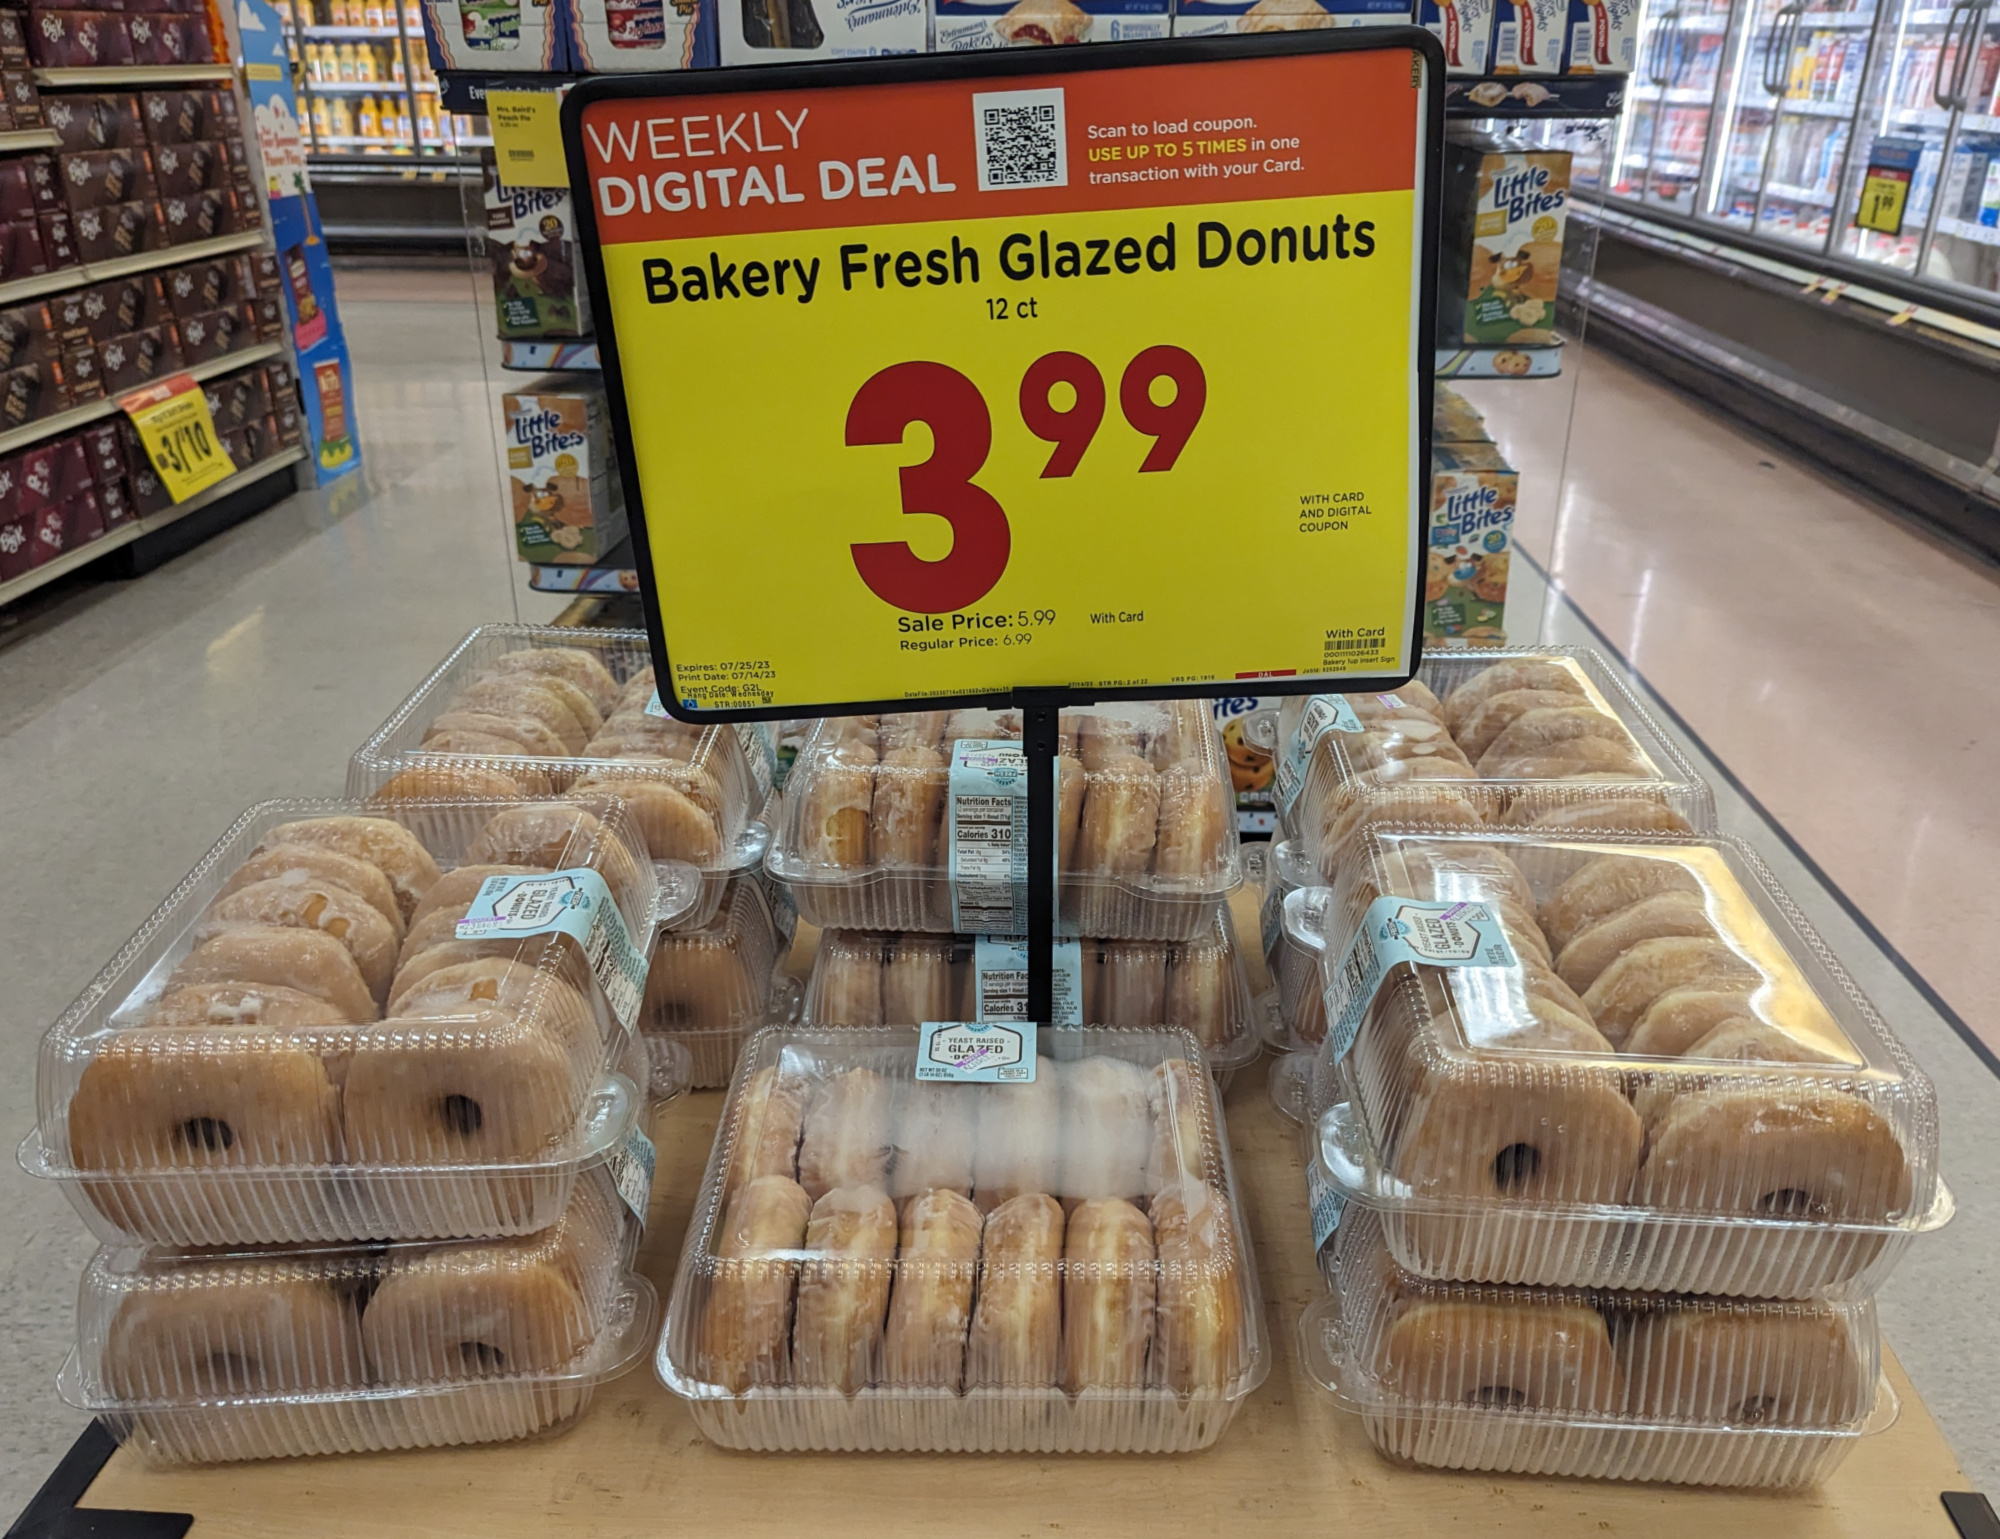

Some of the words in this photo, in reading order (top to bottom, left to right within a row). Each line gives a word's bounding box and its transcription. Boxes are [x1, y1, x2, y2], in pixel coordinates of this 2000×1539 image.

[1111, 19, 1120, 40] 6
[1411, 50, 1420, 88] AKERY
[586, 108, 809, 164] WEEKLY
[1087, 123, 1127, 139] Scan
[1131, 123, 1148, 136] to
[1153, 119, 1188, 134] load
[1193, 117, 1257, 135] coupon.
[1089, 147, 1122, 162] USE
[1126, 145, 1150, 159] UP
[1154, 143, 1178, 157] TO
[1182, 141, 1193, 157] 5
[1196, 138, 1247, 155] TIMES
[1251, 137, 1265, 151] in
[1270, 136, 1300, 149] one
[1089, 166, 1179, 184] transaction
[1184, 163, 1218, 178] with
[1223, 162, 1258, 178] your
[1263, 157, 1305, 173] Card.
[598, 165, 805, 216] DIGITAL
[819, 153, 957, 201] DEAL
[1494, 167, 1549, 209] Little
[1508, 190, 1564, 224] Bites
[642, 251, 820, 304] Bakery
[840, 235, 980, 291] Fresh
[999, 221, 1176, 281] Glazed
[1198, 213, 1376, 269] Donuts
[986, 297, 1009, 320] 12
[1016, 297, 1038, 319] ct
[515, 410, 561, 444] Little
[532, 432, 584, 458] Bites
[1300, 494, 1329, 505] WITH
[1333, 492, 1364, 503] CARD
[1447, 486, 1497, 521] Little
[1299, 508, 1324, 519] AND
[1327, 505, 1372, 517] DIGITAL
[1460, 506, 1514, 535] Bites
[1299, 521, 1348, 532] COUPON
[898, 615, 944, 633] Sale
[951, 612, 1013, 630] Price:
[1017, 609, 1056, 627] 5.99
[1090, 612, 1116, 624] With
[1118, 611, 1144, 623] Card
[900, 638, 954, 652] Regular
[958, 636, 998, 648] Price:
[1003, 633, 1032, 646] 6.99
[1326, 629, 1353, 639] With
[1357, 627, 1385, 636] Card
[676, 663, 717, 672] Expires:
[720, 661, 770, 671] 07/25/23
[1323, 658, 1346, 666] Bakery
[1380, 656, 1395, 664] Sign
[678, 673, 701, 681] Print
[731, 671, 776, 680] 07/14/23
[680, 685, 708, 694] Event
[711, 684, 739, 693] Code:
[957, 796, 989, 806] Nutrition
[992, 797, 1012, 806] Facts
[957, 830, 988, 839] Calories
[991, 829, 1011, 839] 310
[521, 889, 547, 920] GLAZED
[1425, 918, 1450, 950] GLAZED
[983, 971, 1014, 980] Nutrition
[1017, 972, 1028, 980] Fac
[984, 1004, 1014, 1012] Calories
[1017, 1002, 1028, 1012] 31
[948, 1045, 1003, 1054] GLAZED
